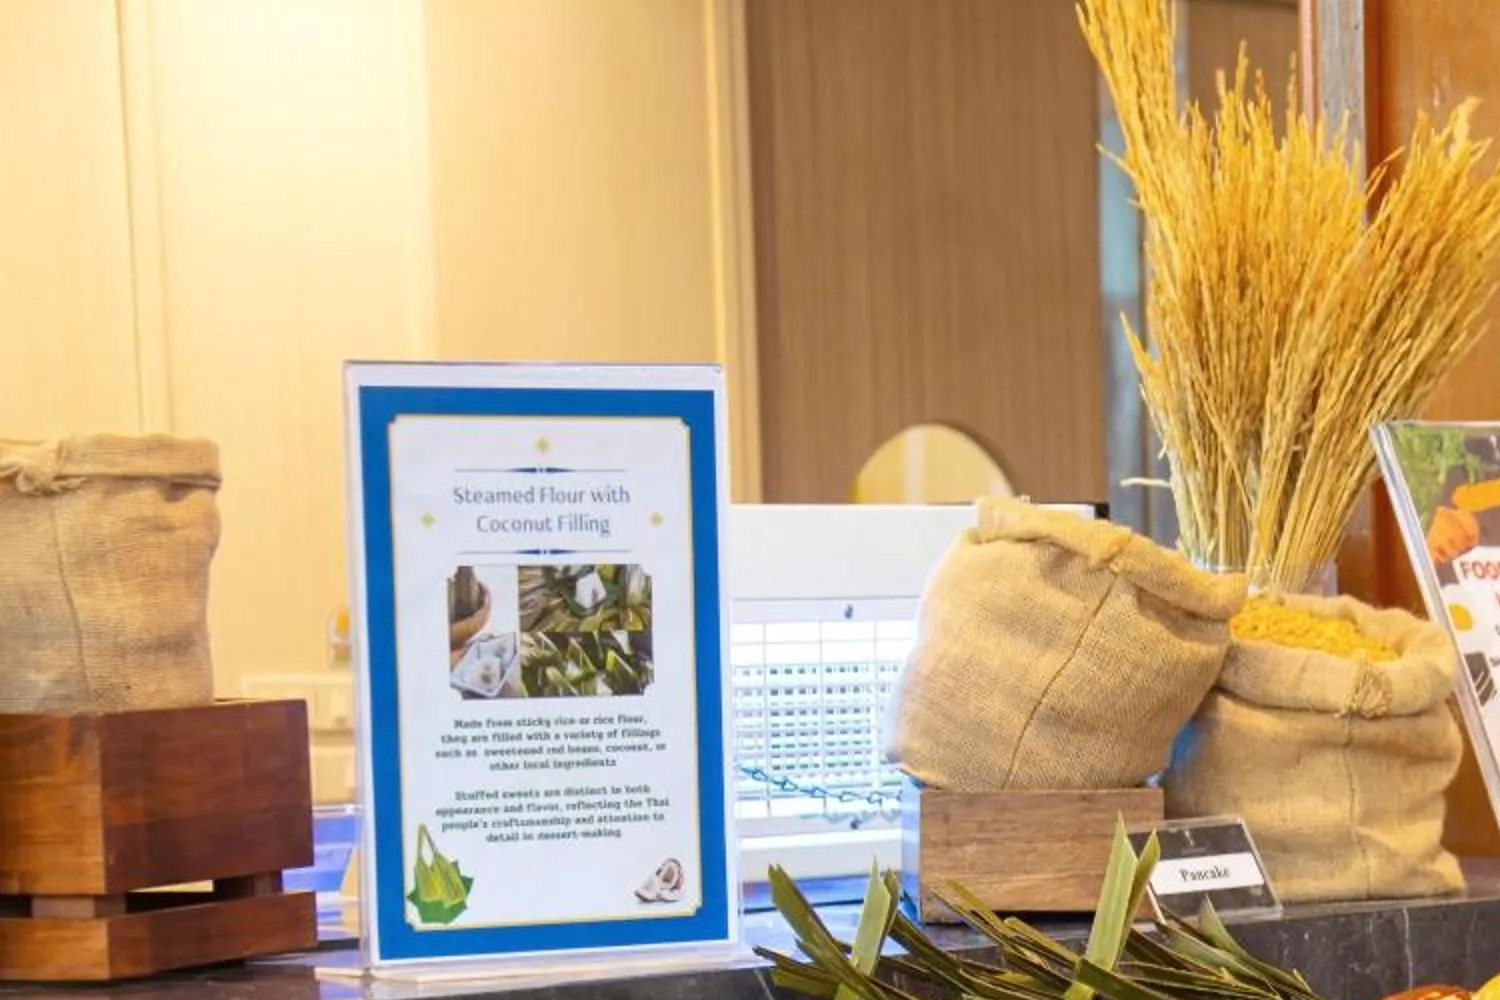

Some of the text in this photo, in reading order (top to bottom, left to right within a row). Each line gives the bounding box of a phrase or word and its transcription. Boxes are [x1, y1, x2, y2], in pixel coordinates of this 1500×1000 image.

[453, 485, 631, 504] Steamed Flour with
[476, 512, 611, 538] Coconut Filling
[454, 719, 482, 729] Made
[485, 718, 513, 729] from
[516, 717, 551, 728] sticky
[554, 715, 576, 725] rice
[593, 714, 614, 725] rice
[441, 728, 661, 745] they are filled with a variety of fillings
[435, 749, 462, 758] such
[484, 746, 543, 757] sweetened
[547, 745, 564, 755] red
[489, 758, 616, 771] other local ingredients
[455, 784, 650, 801] Stuffed sweets are distinct in both
[435, 806, 500, 818] appearance
[504, 804, 523, 813] and
[565, 799, 621, 811] reflecting
[624, 799, 643, 808] the
[646, 797, 669, 807] Thai
[441, 812, 664, 833] people's craftsmanship and attention to
[486, 828, 621, 842] detail in dessert-making
[1180, 864, 1232, 882] Pancake
